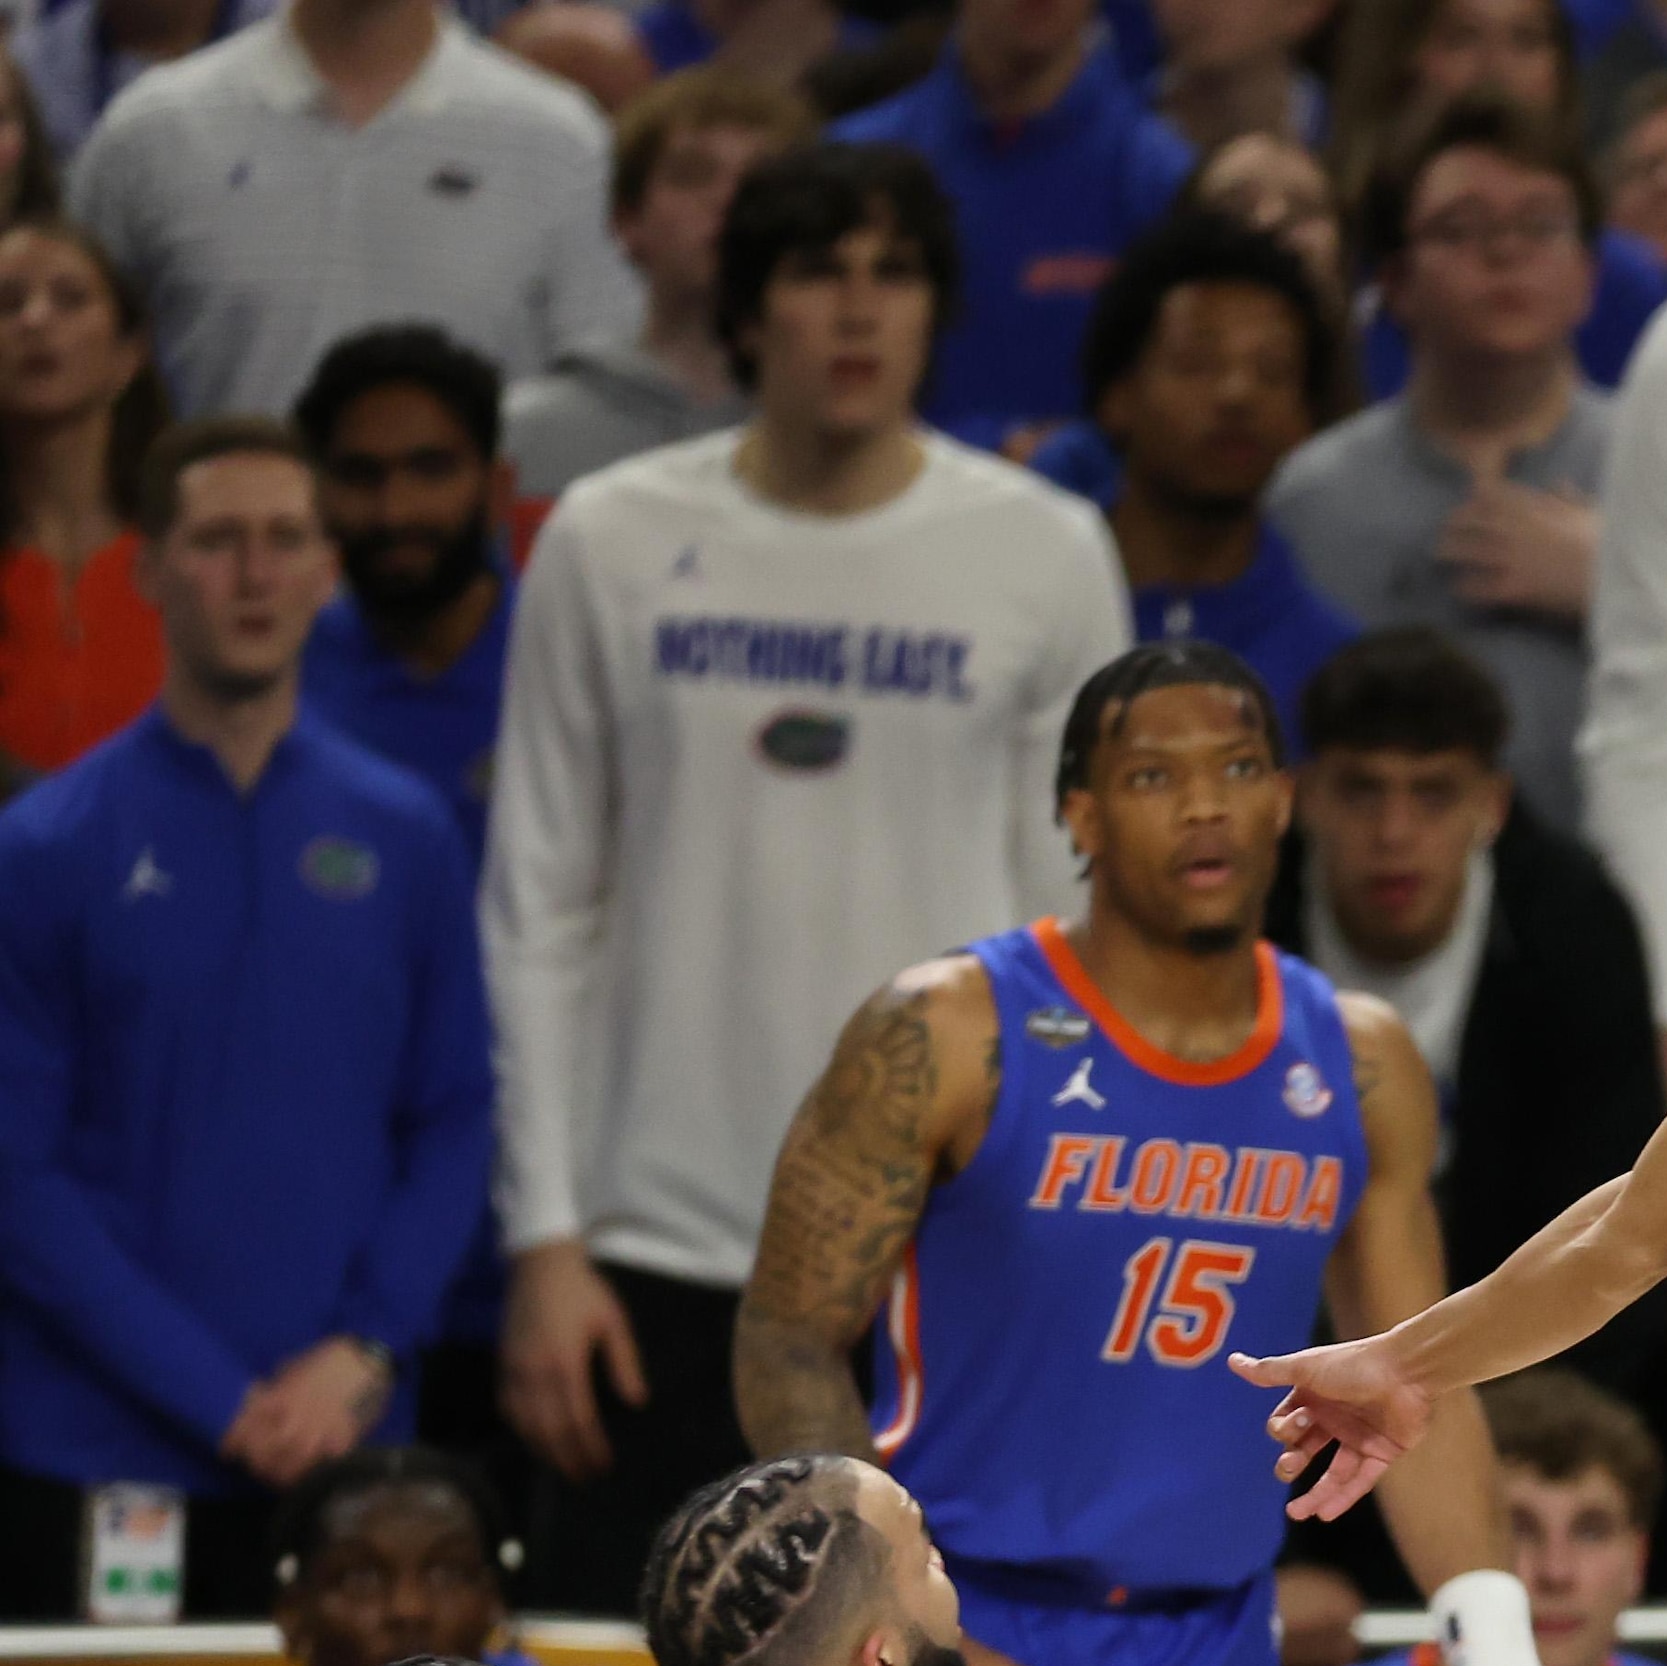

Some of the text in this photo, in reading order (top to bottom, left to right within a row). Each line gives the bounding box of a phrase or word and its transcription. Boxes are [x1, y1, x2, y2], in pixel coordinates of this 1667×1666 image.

[655, 612, 848, 690] NOTHING
[1028, 1131, 1344, 1233] FLORIDA
[1102, 1236, 1256, 1370] 15
